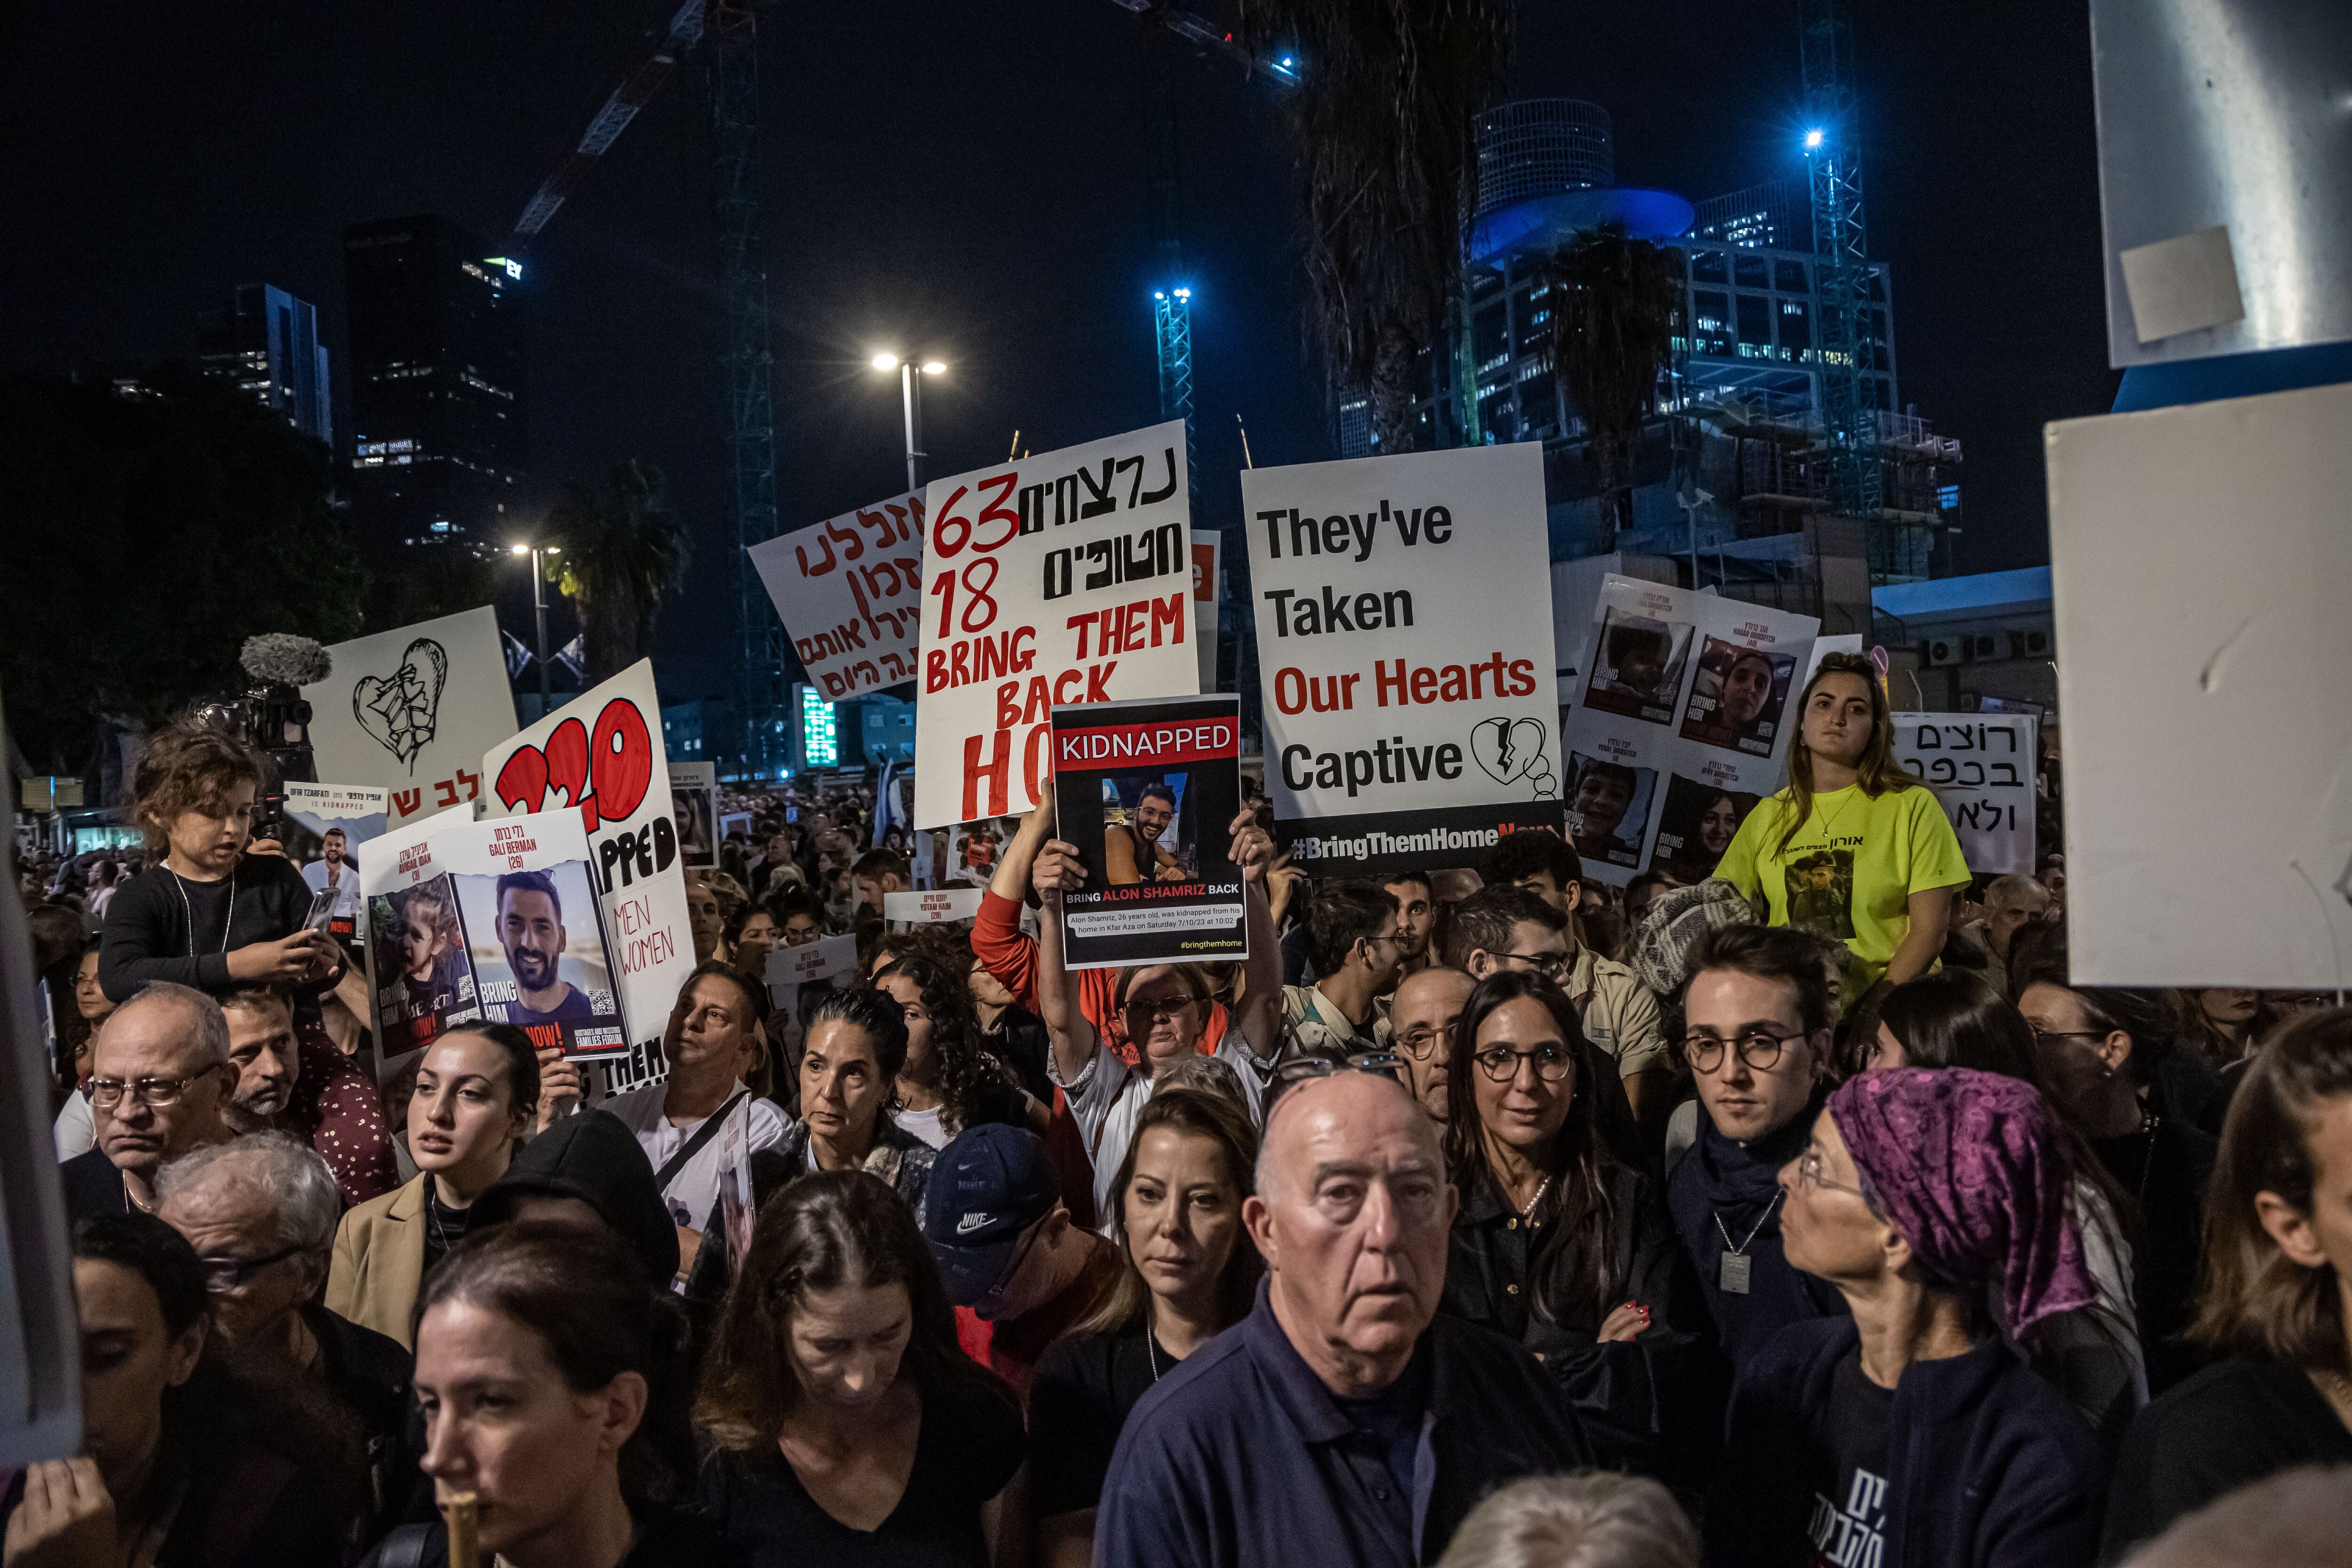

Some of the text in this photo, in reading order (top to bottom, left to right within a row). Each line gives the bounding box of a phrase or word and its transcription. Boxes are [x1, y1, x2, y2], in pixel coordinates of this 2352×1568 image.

[507, 259, 522, 280] EY
[933, 471, 1020, 559] 63
[1256, 499, 1452, 563] They've
[930, 523, 1184, 639] 18 חטופים
[1264, 585, 1414, 637] Taken
[927, 626, 1036, 694] BRING
[1067, 592, 1184, 661] THEM
[1274, 667, 1360, 715] Our
[1375, 652, 1536, 707] Hearts
[997, 661, 1117, 730] BACK
[1691, 694, 1716, 711] BRING
[1687, 707, 1704, 722] HER
[1063, 725, 1231, 761] KIDNAPPED
[1917, 723, 2016, 752] רוצים
[961, 722, 1053, 821] HO
[1281, 736, 1463, 798] Captive
[323, 801, 363, 810] KIDNAPPED
[1957, 799, 2015, 831] ולא
[494, 825, 524, 842] גלי ברמן
[1659, 832, 1684, 849] BRING
[1830, 836, 1863, 850] אורון
[399, 842, 428, 863] אביגיל עידן
[489, 839, 537, 856] GALI BERMAN
[599, 817, 676, 894] PPED
[399, 853, 431, 875] AVIGAIL IDAN
[509, 854, 524, 870] (26)
[1067, 883, 1239, 903] BRING ALON SHAMRIZ BACK
[614, 895, 651, 939] MEN
[920, 903, 937, 911] YOTAM
[1088, 914, 1117, 923] Shamriz,
[1176, 907, 1211, 917] kidnapped
[331, 921, 352, 933] NOW!
[1147, 921, 1176, 929] Saturday
[619, 925, 674, 975] WOMEN
[1181, 940, 1242, 949] #bringthemhome
[380, 981, 407, 1008] BRING
[479, 980, 517, 1003] BRING
[485, 1004, 509, 1024] HIM
[576, 1034, 623, 1047] FAMILIES FORUM
[599, 1035, 666, 1091] THEM
[962, 1213, 987, 1226] NIKE
